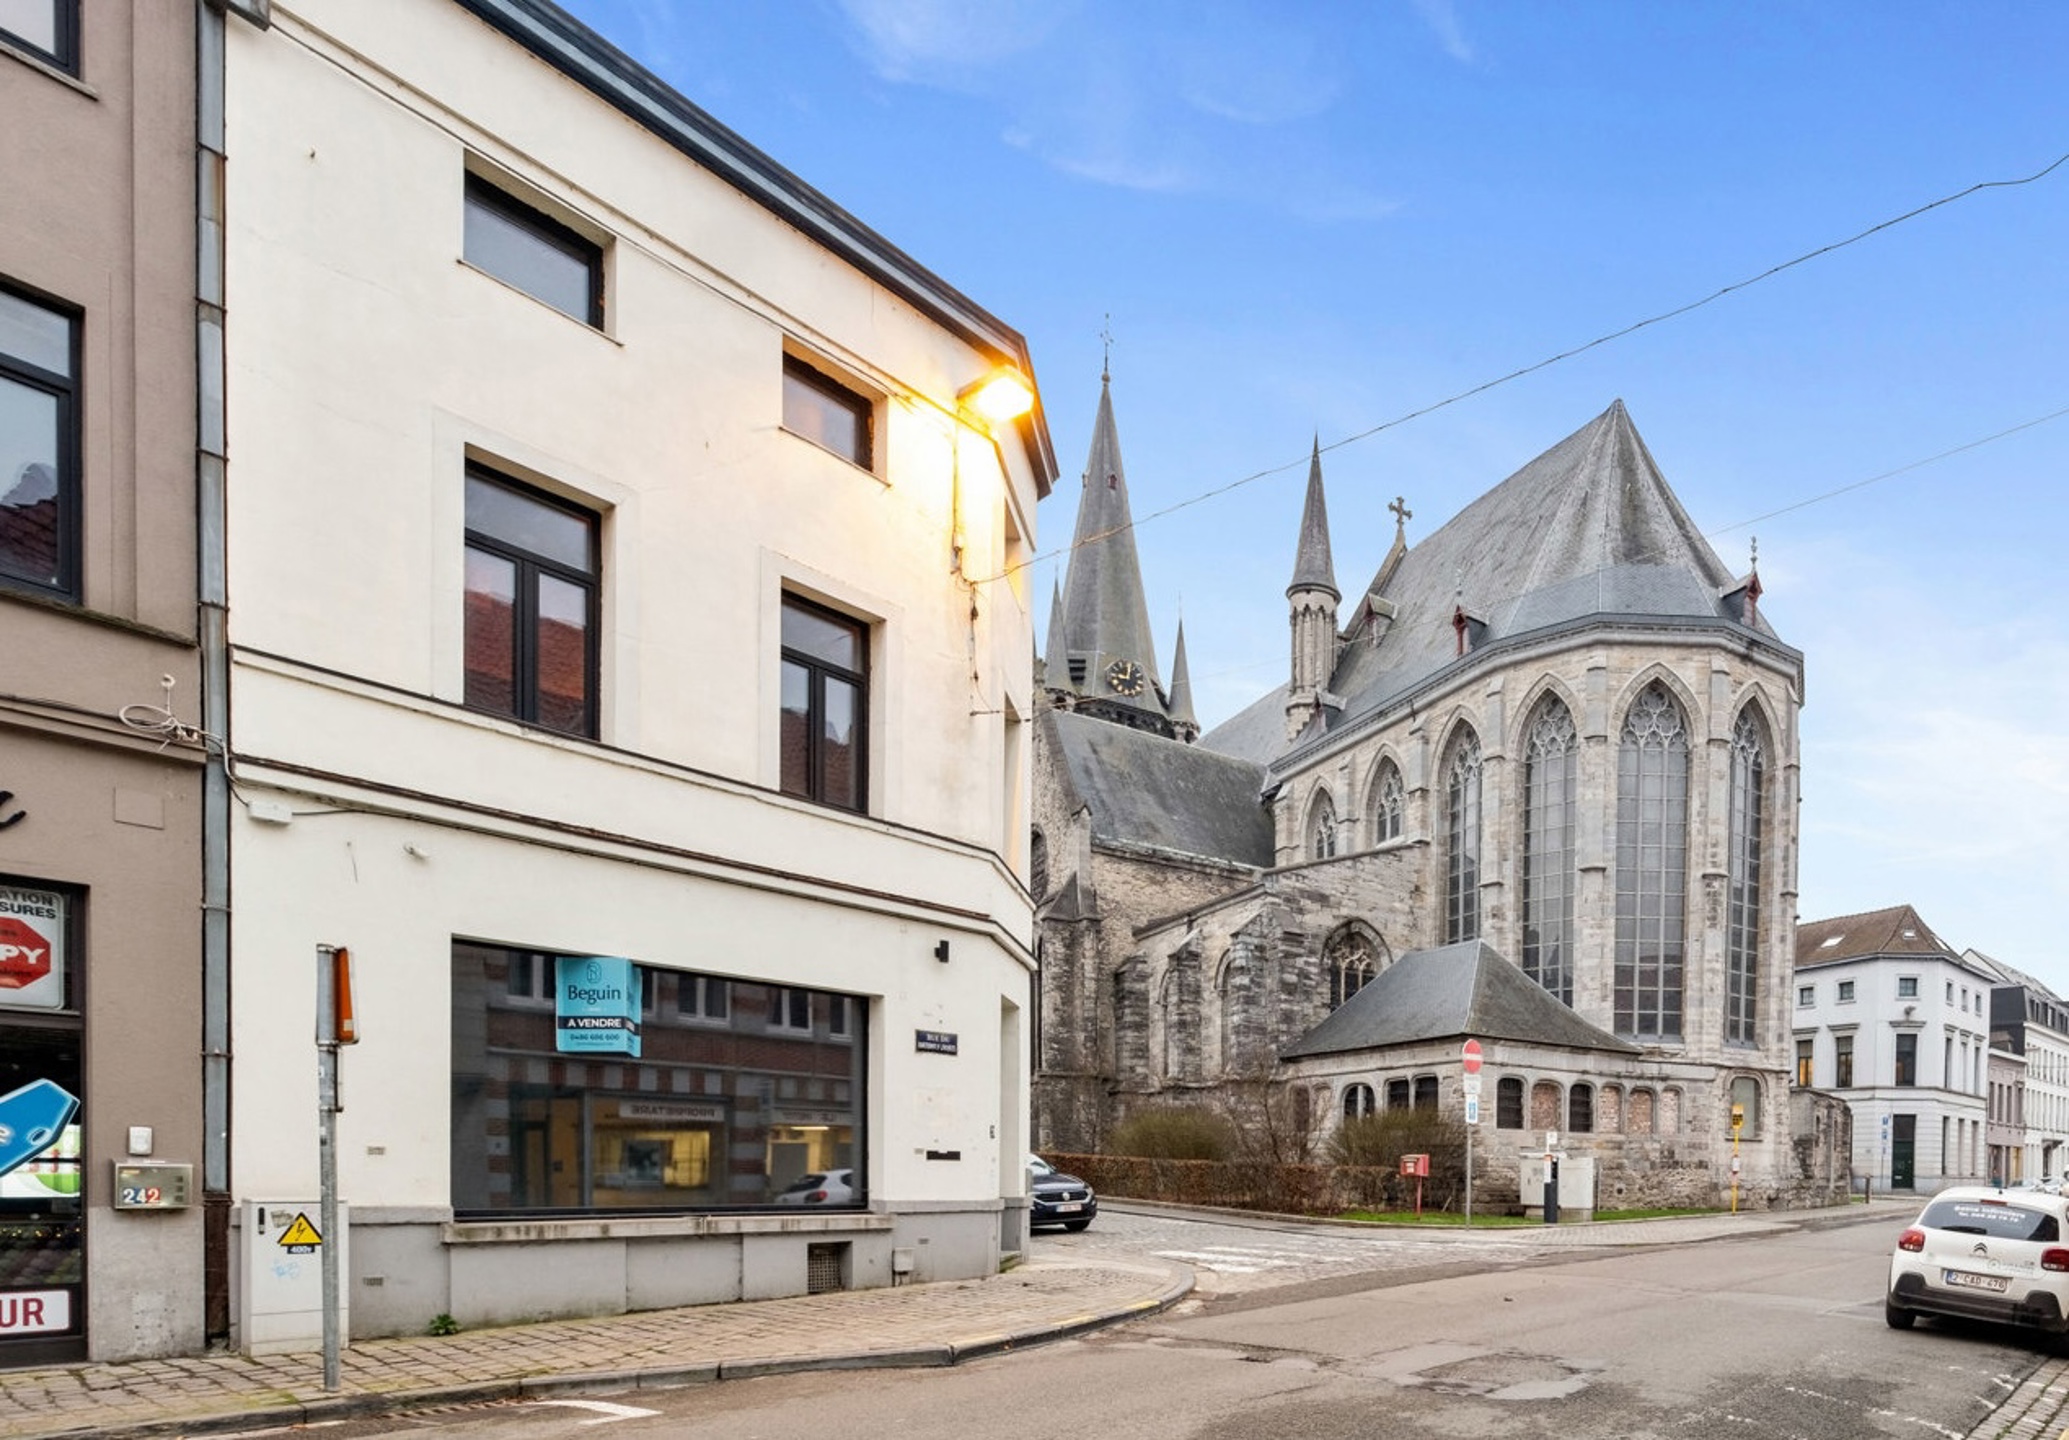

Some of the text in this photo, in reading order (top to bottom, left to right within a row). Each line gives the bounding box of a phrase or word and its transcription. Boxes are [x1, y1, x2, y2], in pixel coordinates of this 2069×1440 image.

[567, 984, 621, 1005] Beguin
[567, 1018, 577, 1028] A
[578, 1018, 622, 1028] VENDRE
[123, 1188, 160, 1204] 242
